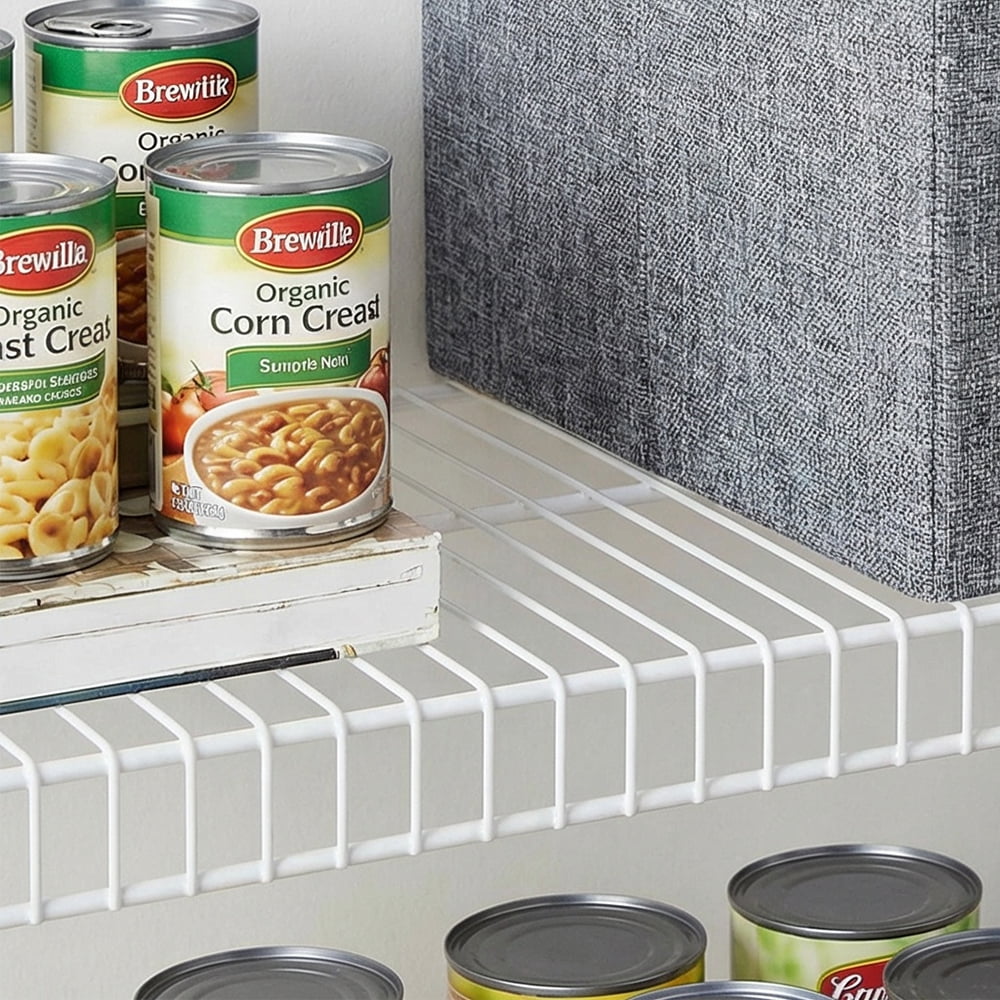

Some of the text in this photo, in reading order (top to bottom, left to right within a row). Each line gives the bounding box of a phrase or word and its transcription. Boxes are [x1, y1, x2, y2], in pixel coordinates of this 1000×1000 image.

[256, 276, 350, 308] Organic
[211, 308, 290, 336] Corn
[0, 333, 36, 360] st
